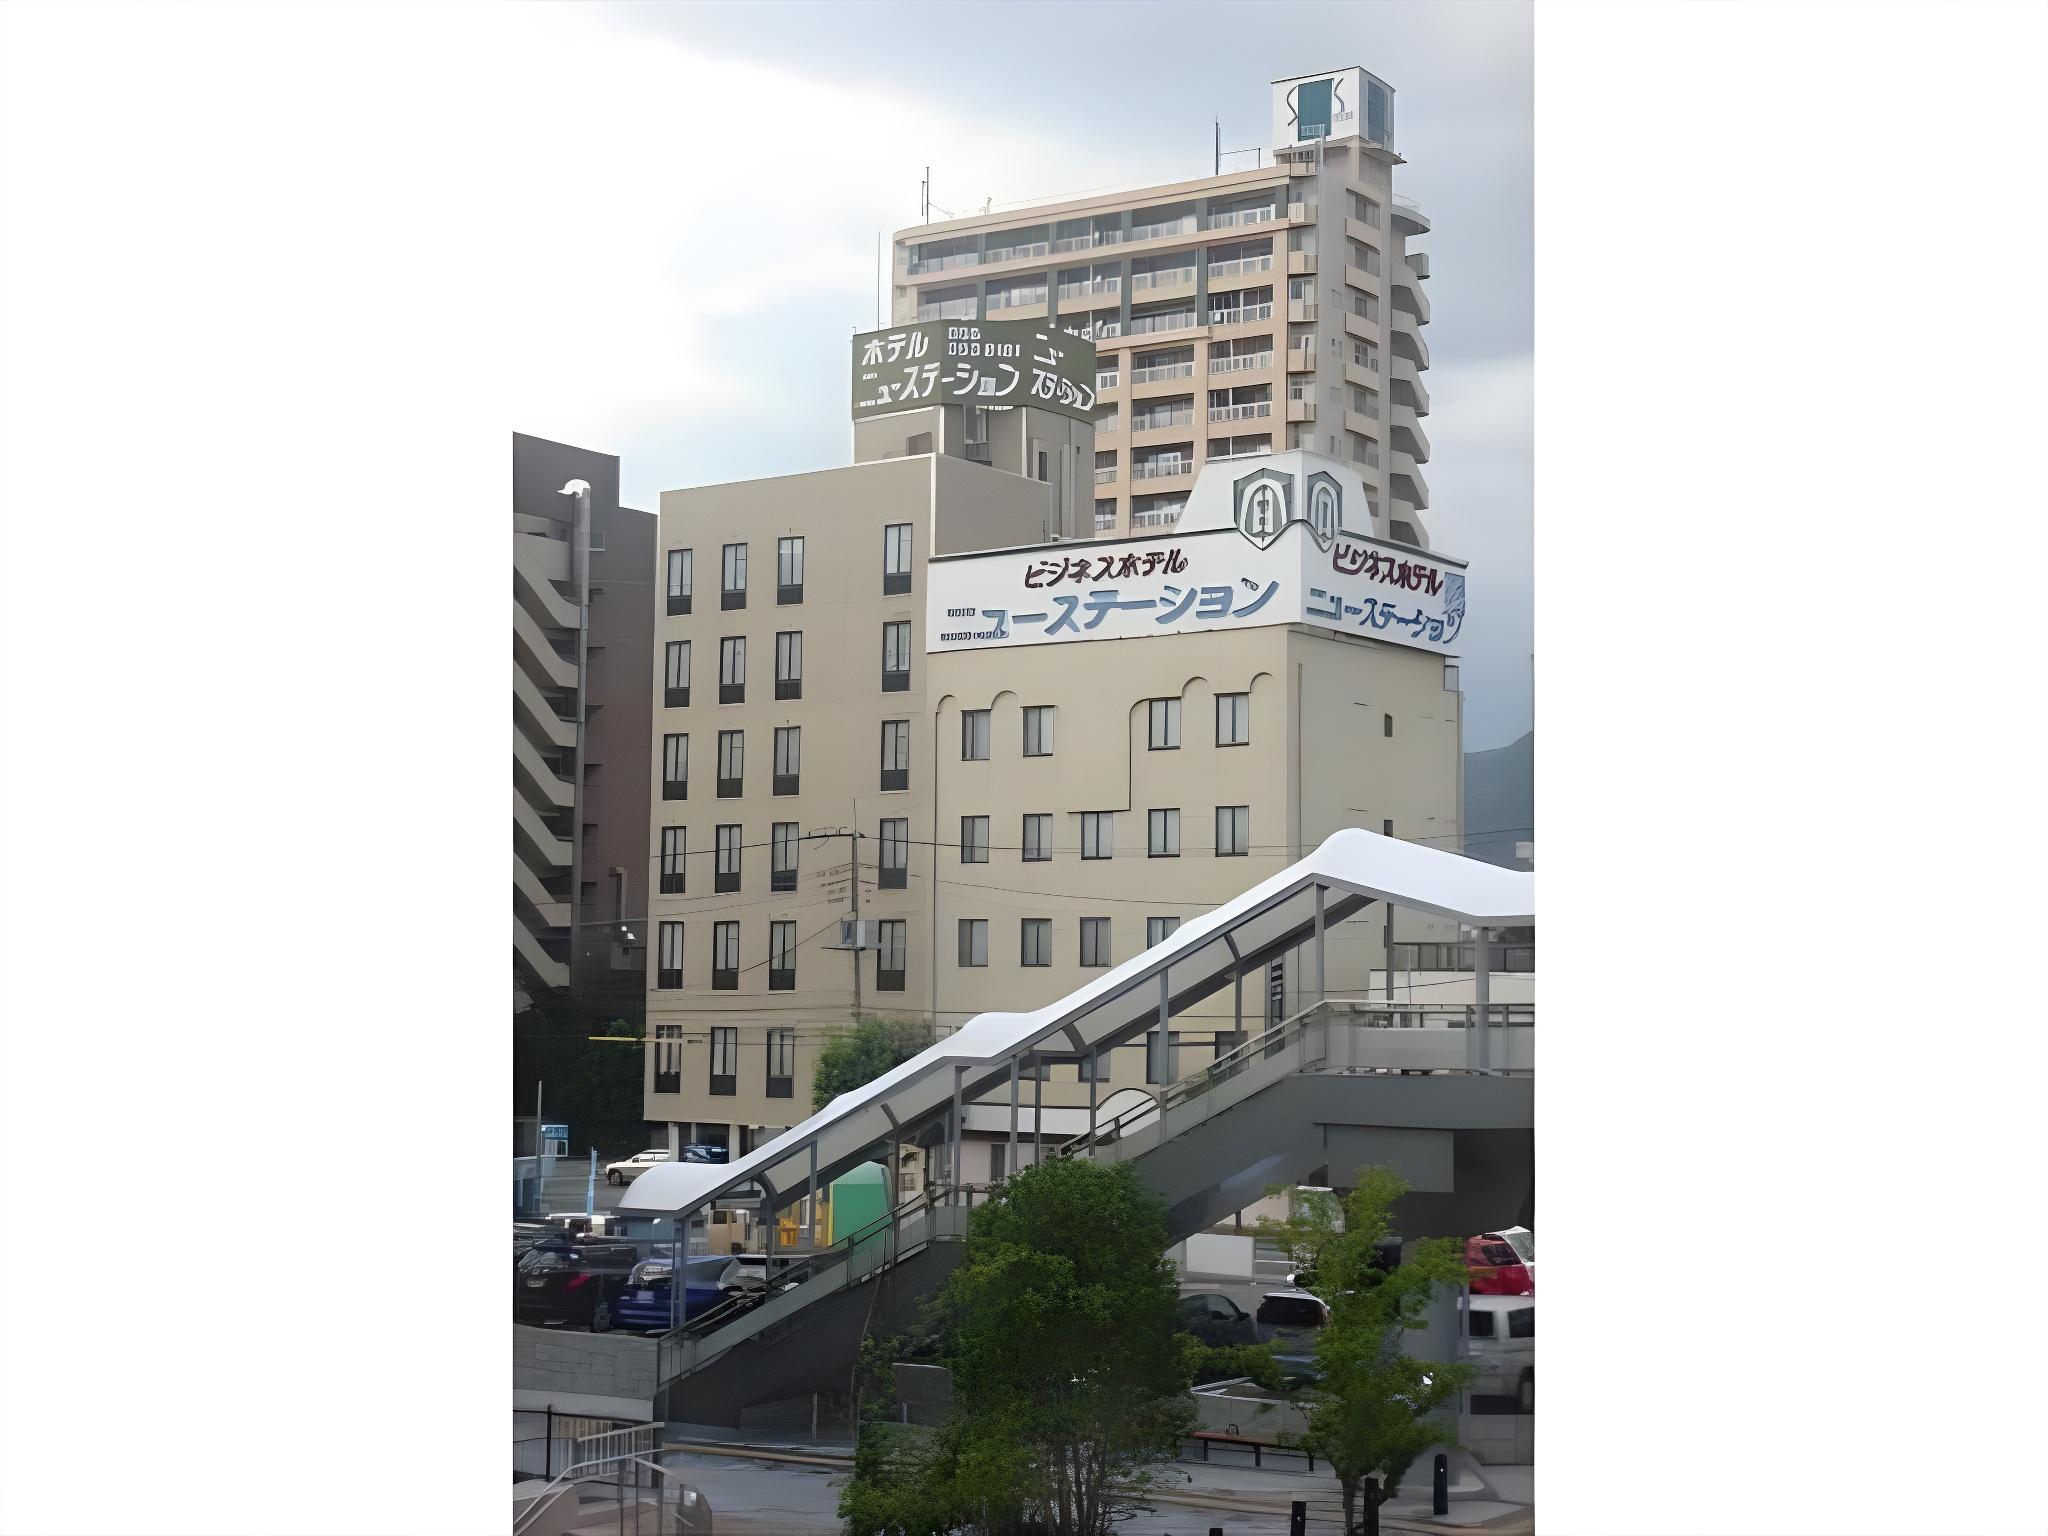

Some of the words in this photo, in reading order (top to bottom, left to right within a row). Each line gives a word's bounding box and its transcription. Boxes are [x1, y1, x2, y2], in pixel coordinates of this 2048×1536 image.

[862, 331, 929, 366] ホテル
[1025, 548, 1189, 588] ビジネスホテル
